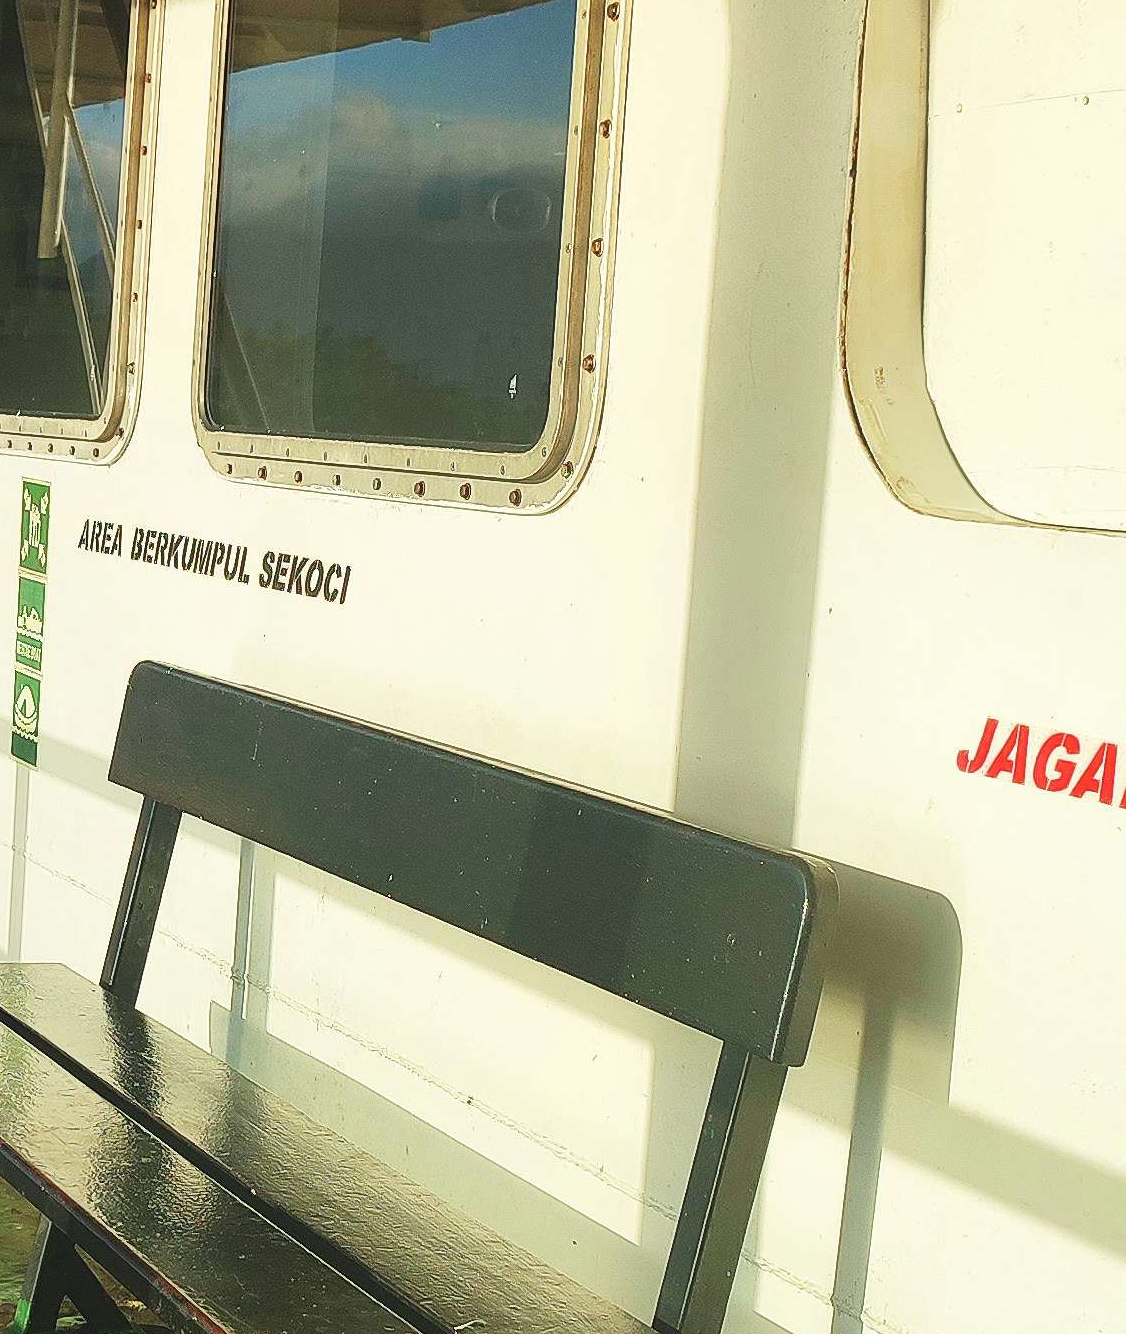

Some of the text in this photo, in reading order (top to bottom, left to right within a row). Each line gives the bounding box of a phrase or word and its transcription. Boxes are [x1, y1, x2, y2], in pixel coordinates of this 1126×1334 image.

[77, 518, 352, 605] AREA BERKUMPUL SEKOCI
[956, 717, 1126, 809] JAGA
